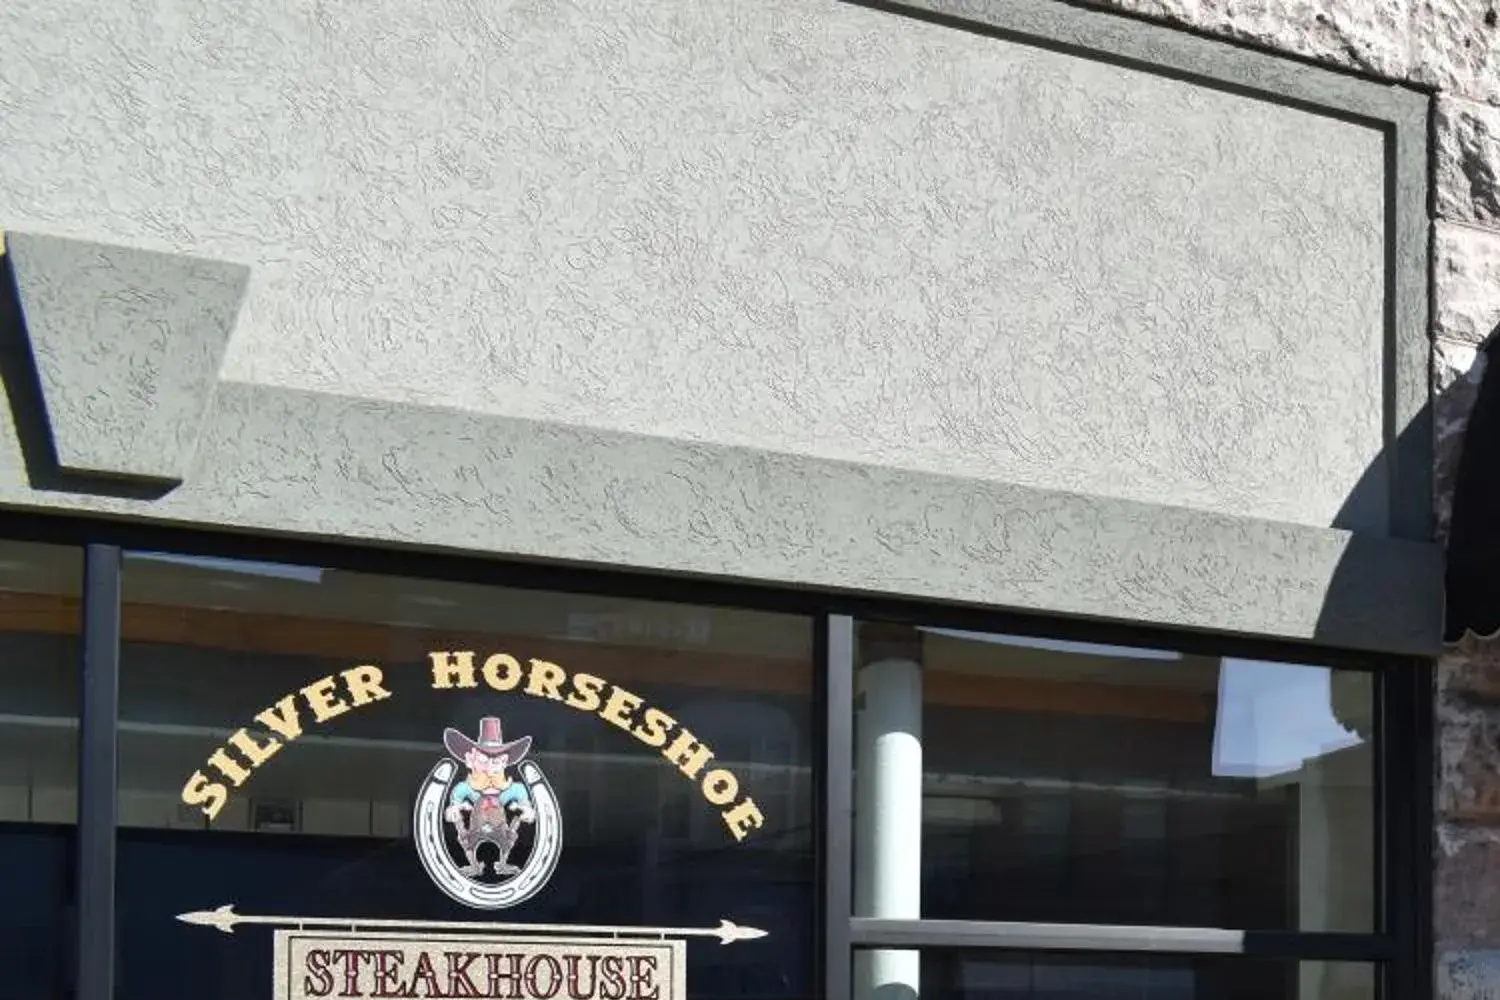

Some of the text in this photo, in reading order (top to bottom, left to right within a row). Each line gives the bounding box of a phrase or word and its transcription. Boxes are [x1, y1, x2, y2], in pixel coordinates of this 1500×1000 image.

[182, 650, 765, 842] SILVER HORSESHOE
[304, 949, 660, 1000] STEAKHOUSE
